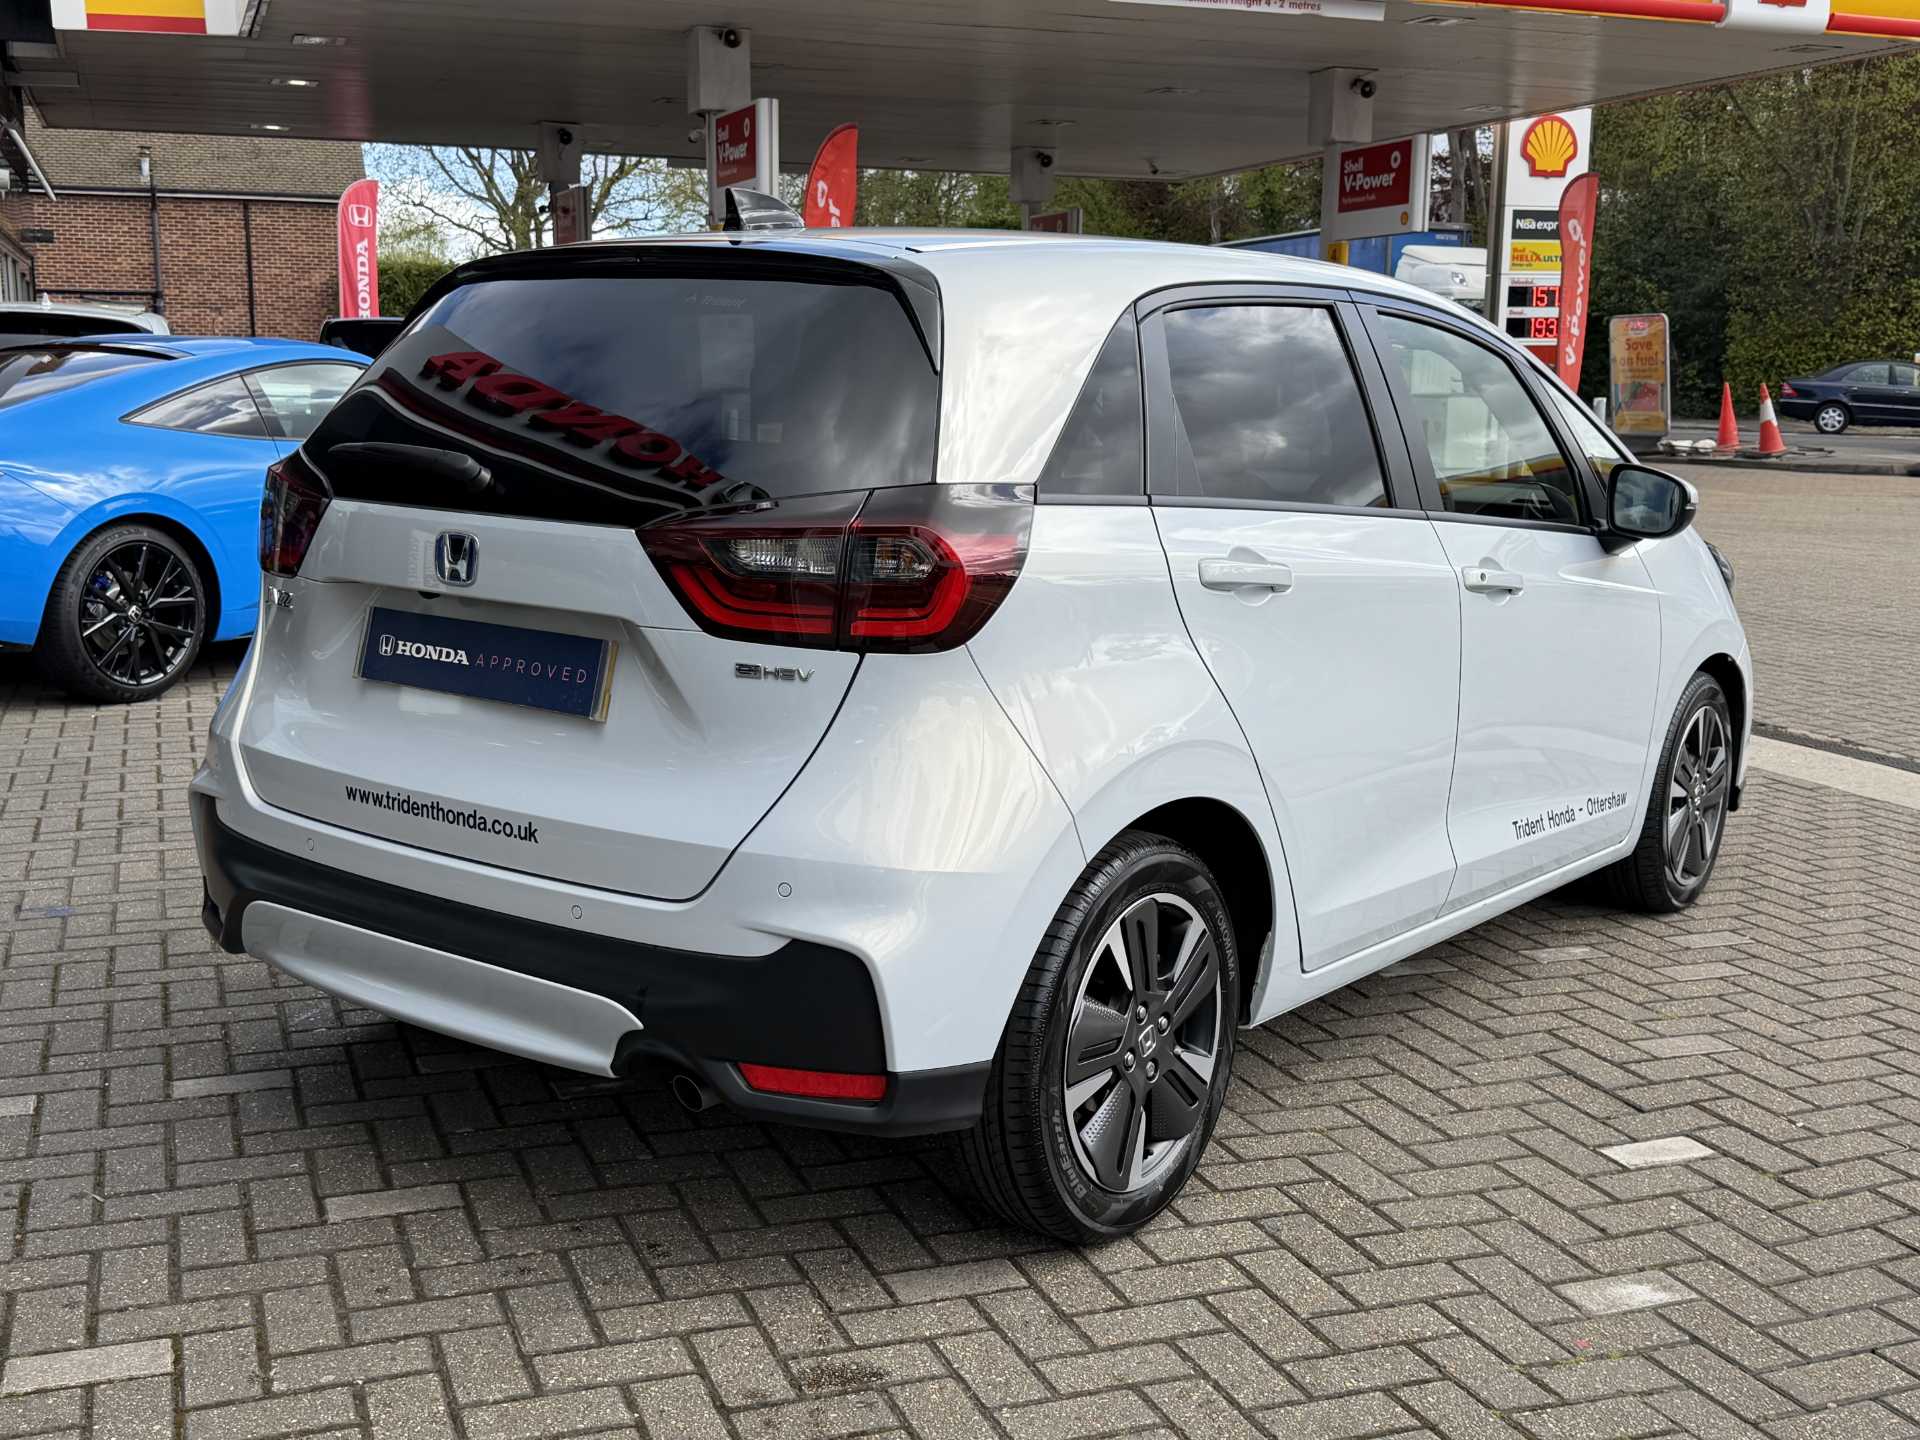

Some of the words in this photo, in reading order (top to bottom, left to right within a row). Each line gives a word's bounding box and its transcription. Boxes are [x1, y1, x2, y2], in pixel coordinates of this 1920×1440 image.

[1288, 1, 1322, 11] metres
[1343, 157, 1364, 174] Shell
[1344, 172, 1396, 193] V-Power
[1565, 231, 1587, 366] V-Power
[1625, 338, 1653, 352] Save
[396, 640, 470, 666] HONDA
[474, 653, 588, 684] APPROVED
[345, 785, 540, 844] www.tridenthonda.co.uk
[1512, 814, 1546, 841] Trident
[1546, 804, 1576, 830] Honda
[1586, 791, 1627, 816] Ottershaw
